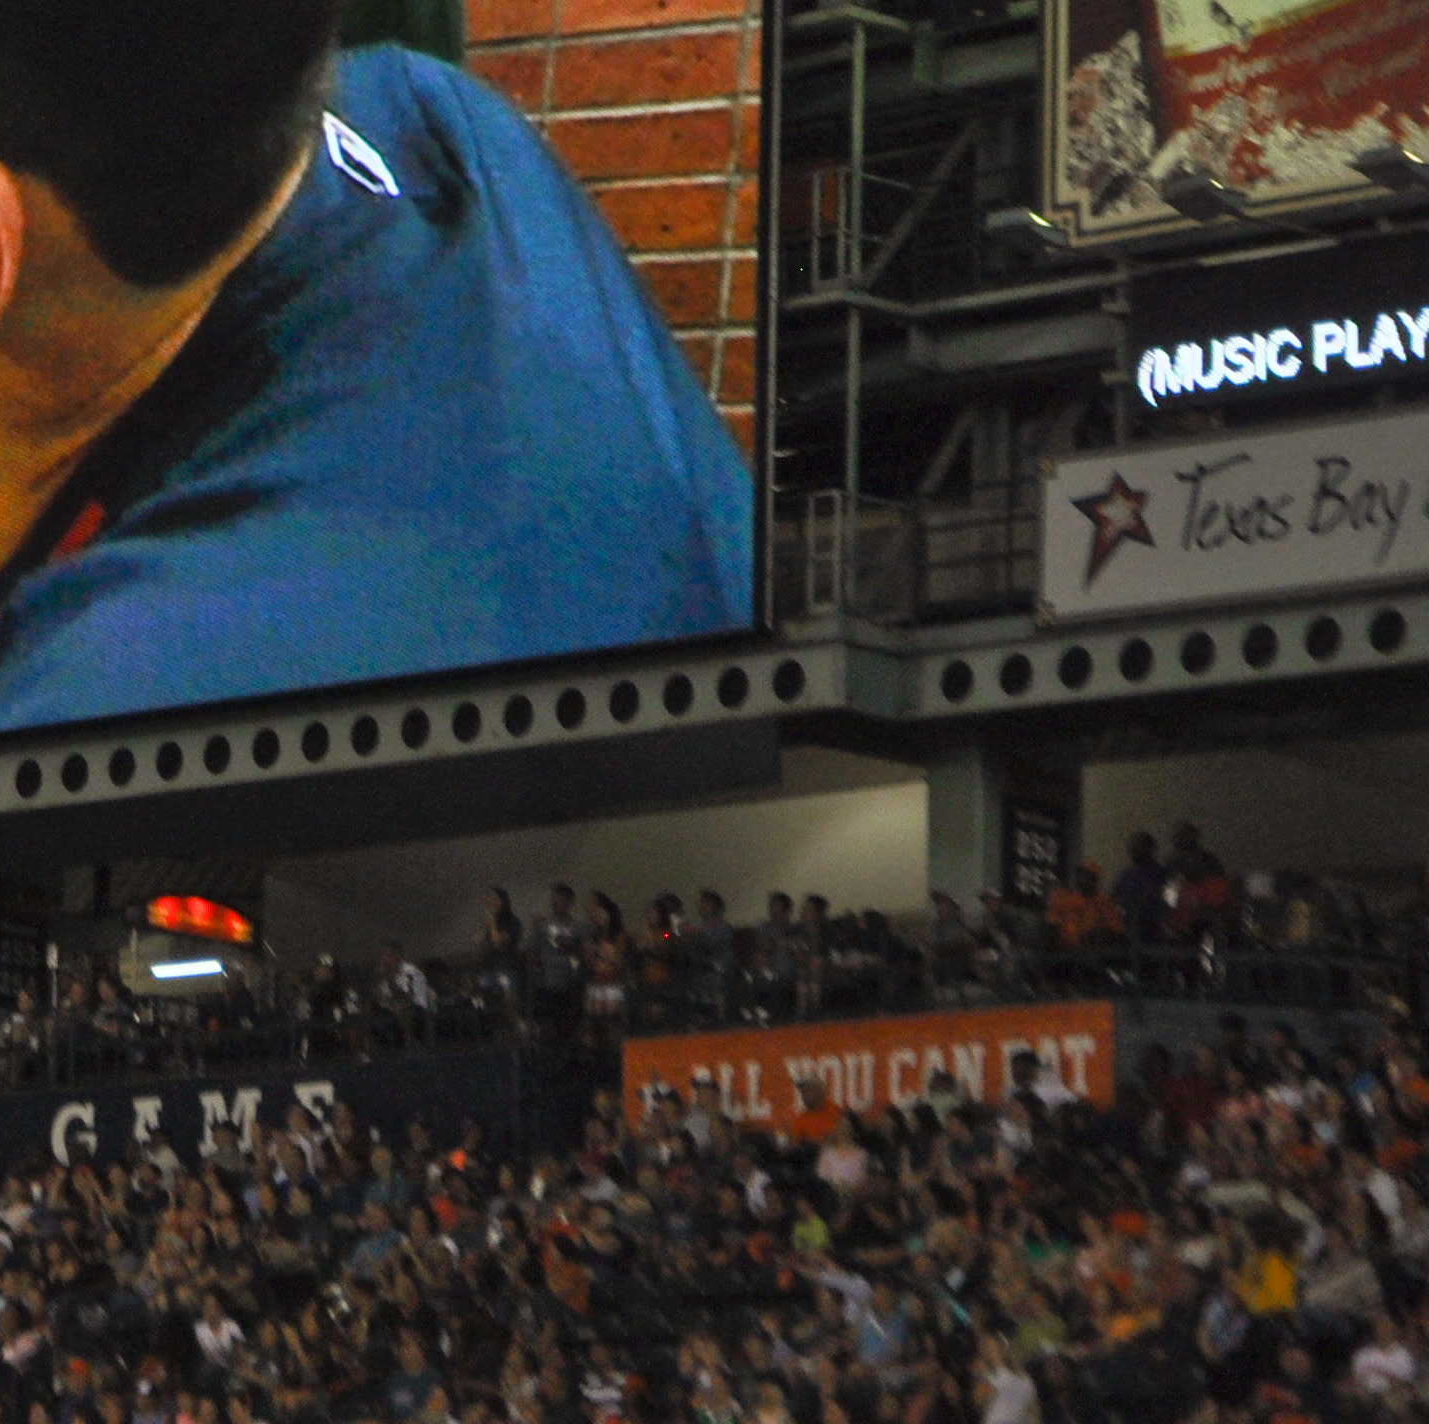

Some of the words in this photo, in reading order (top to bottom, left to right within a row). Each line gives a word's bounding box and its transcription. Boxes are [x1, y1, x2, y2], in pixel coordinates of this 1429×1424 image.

[1137, 327, 1304, 408] (MUSIC
[1174, 452, 1295, 552] Texas
[1307, 455, 1412, 568] Bay
